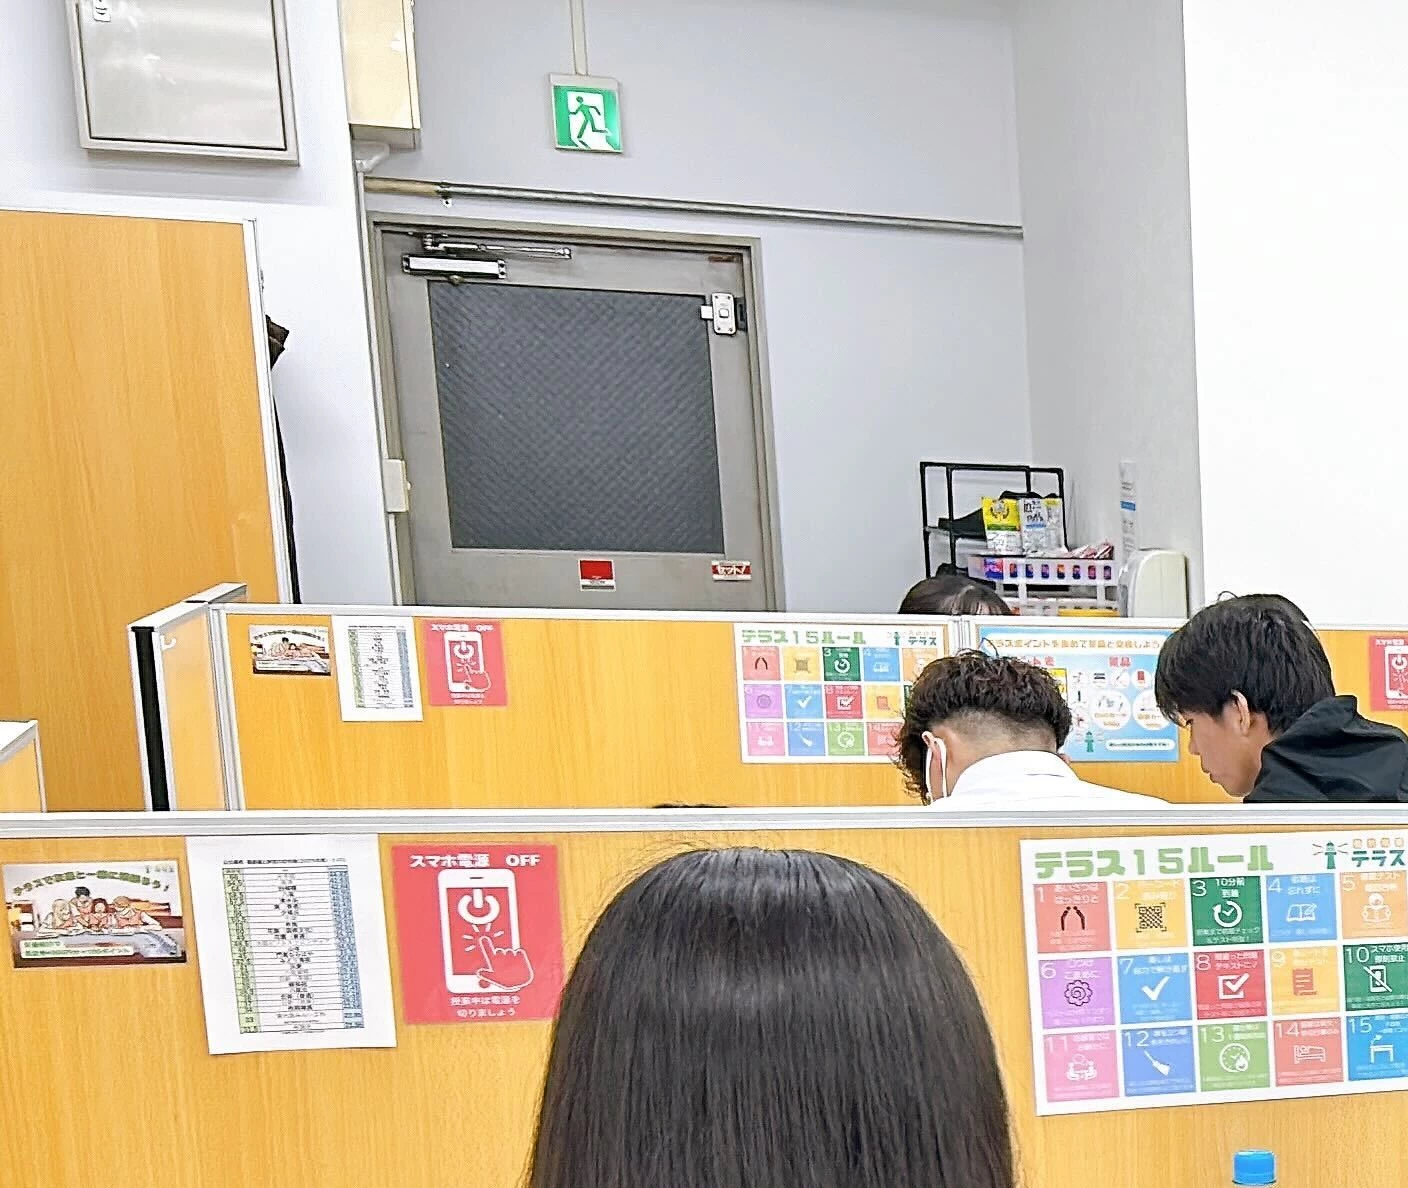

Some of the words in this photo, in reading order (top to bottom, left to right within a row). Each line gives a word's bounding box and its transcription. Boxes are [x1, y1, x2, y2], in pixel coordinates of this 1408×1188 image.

[410, 853, 490, 868] スマホ電源
[505, 854, 541, 867] OFF
[1035, 845, 1274, 880] テラス15ルール
[1352, 850, 1406, 868] テラス
[1192, 880, 1208, 897] 3
[1268, 878, 1282, 893] 4
[1342, 876, 1356, 892] 5
[1036, 886, 1046, 903] 1
[1195, 954, 1212, 971] 8
[1346, 946, 1370, 964] 10
[1041, 962, 1056, 979] 6
[1120, 958, 1134, 975] 7
[1276, 1021, 1300, 1038] 14
[1350, 1017, 1372, 1034] 15
[1124, 1030, 1150, 1048] 12
[1200, 1026, 1225, 1044] 13
